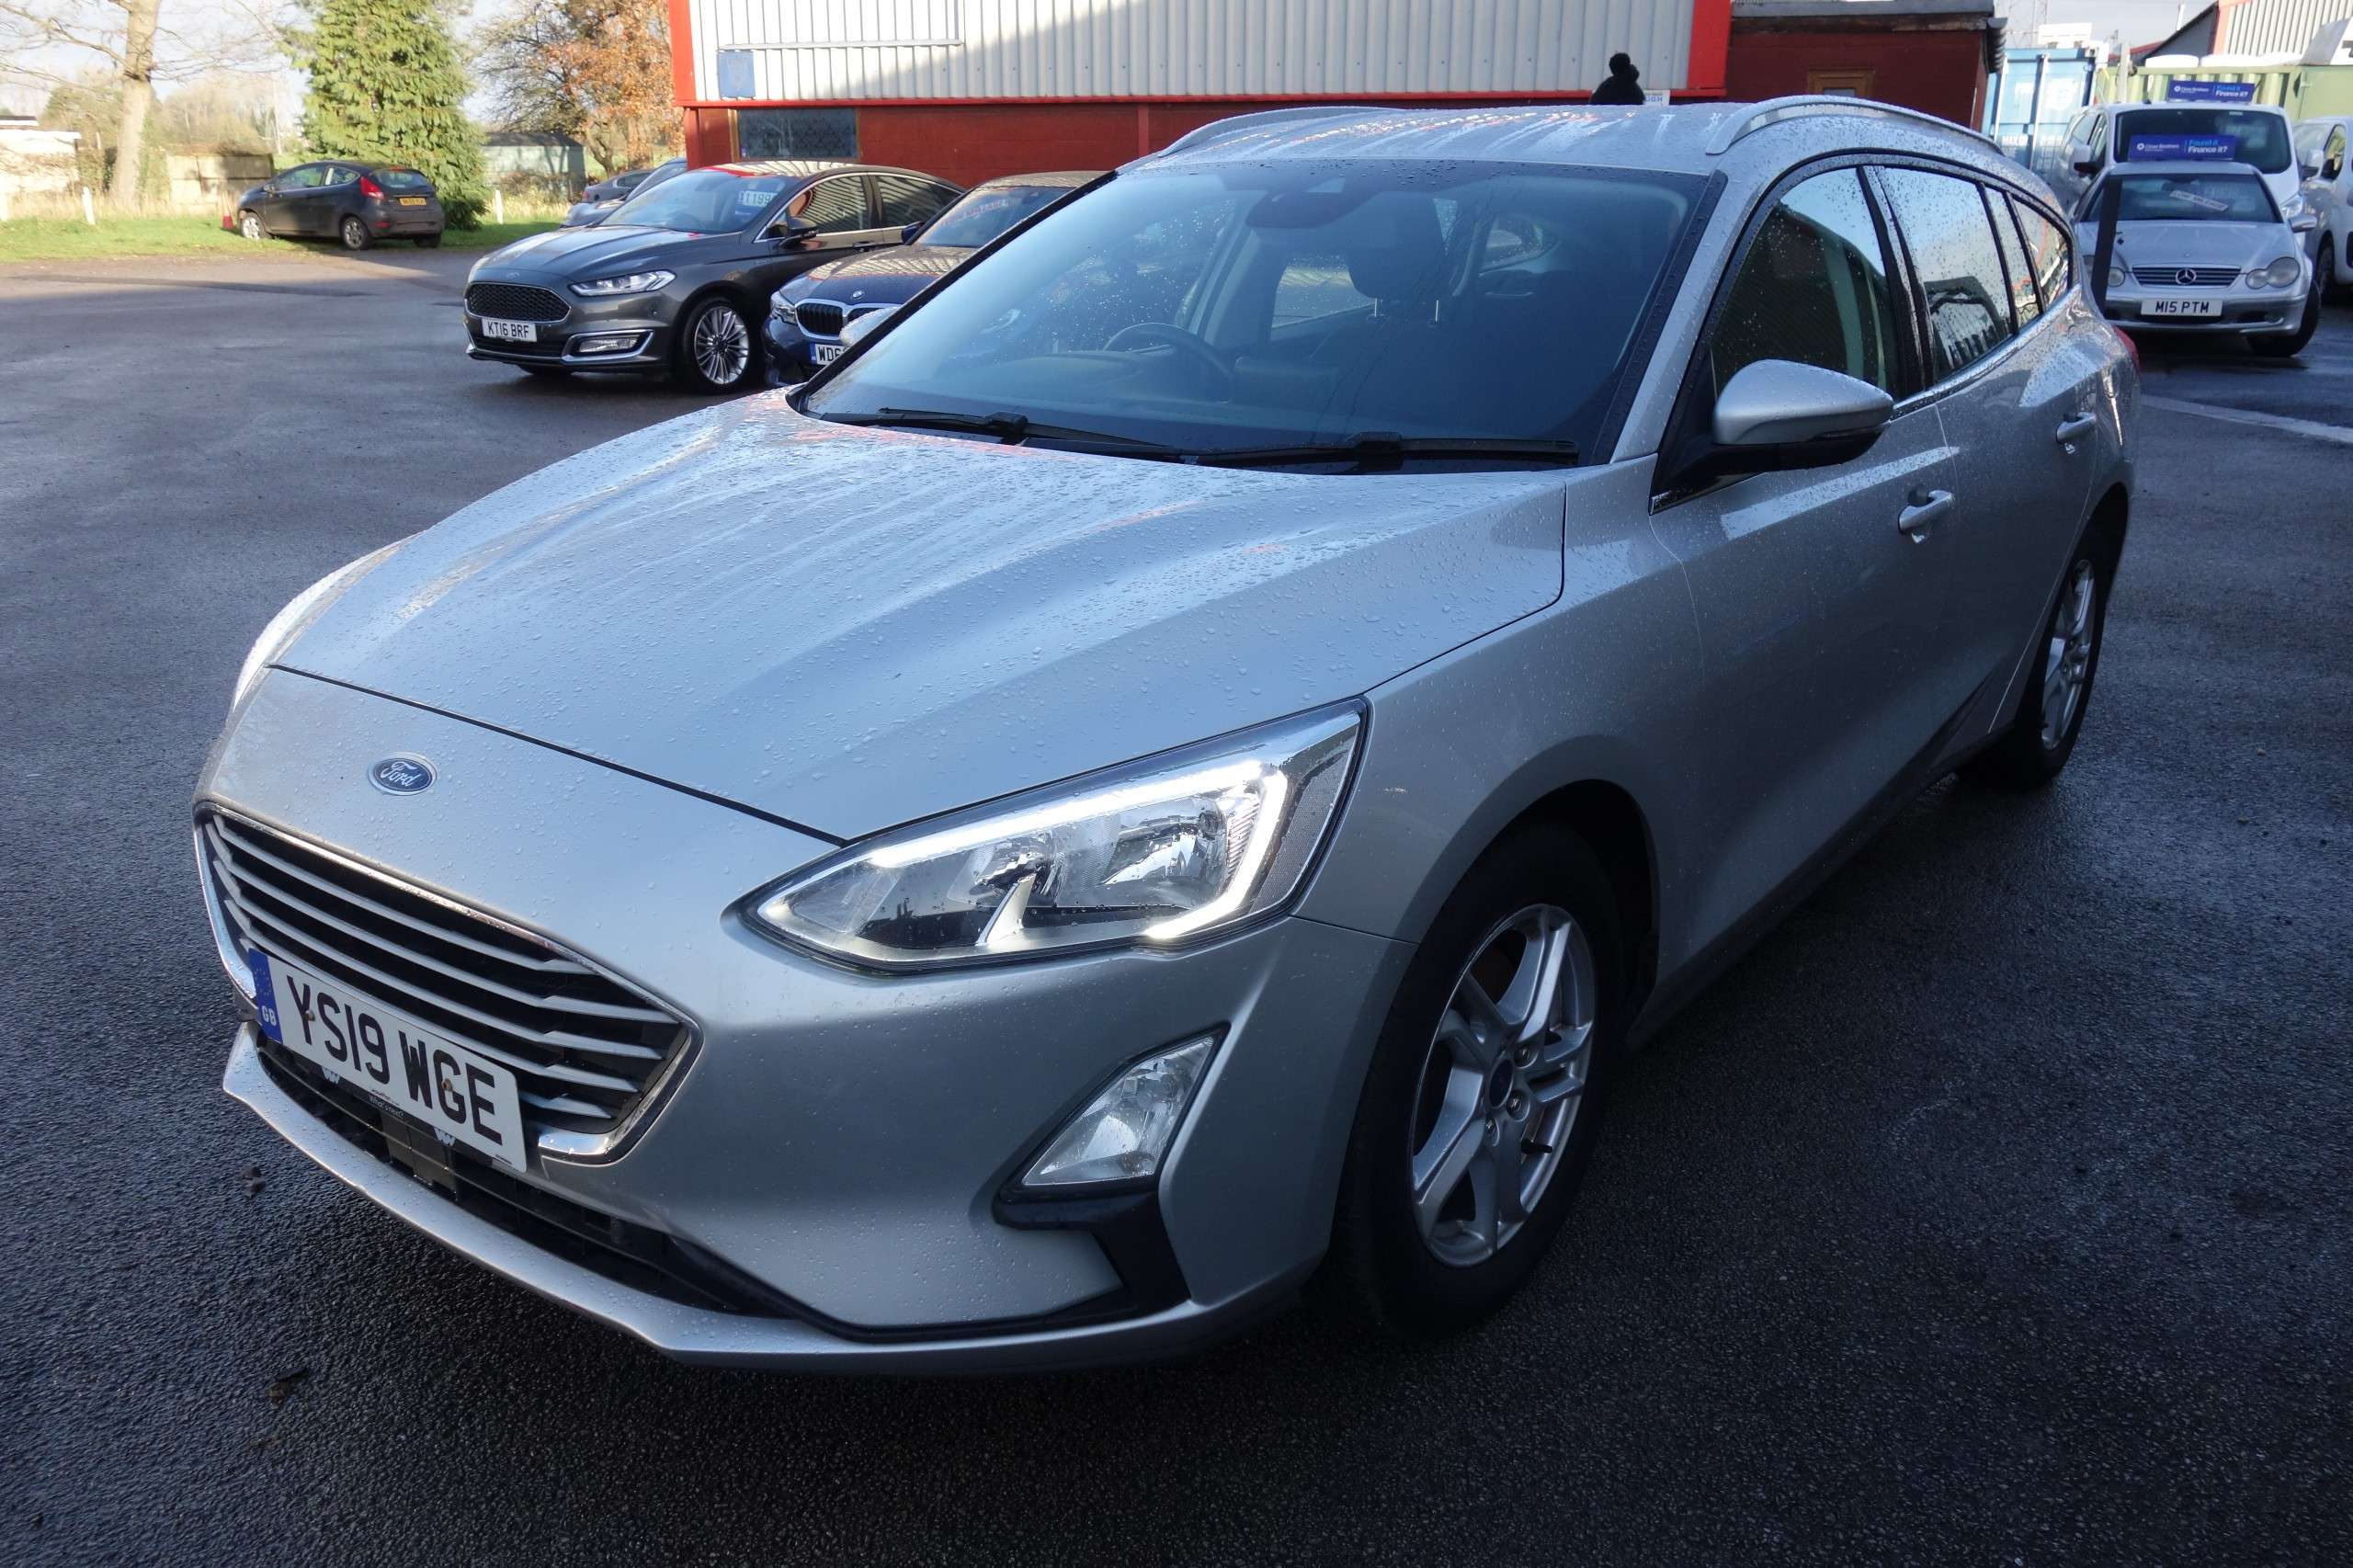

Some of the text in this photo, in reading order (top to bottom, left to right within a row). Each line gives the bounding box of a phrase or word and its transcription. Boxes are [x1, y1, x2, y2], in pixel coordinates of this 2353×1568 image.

[2155, 301, 2210, 313] M15 PTM
[487, 322, 529, 338] KT16 BRF
[380, 761, 421, 787] Ford
[261, 1005, 278, 1027] GB
[286, 974, 503, 1146] YS19 WGE
